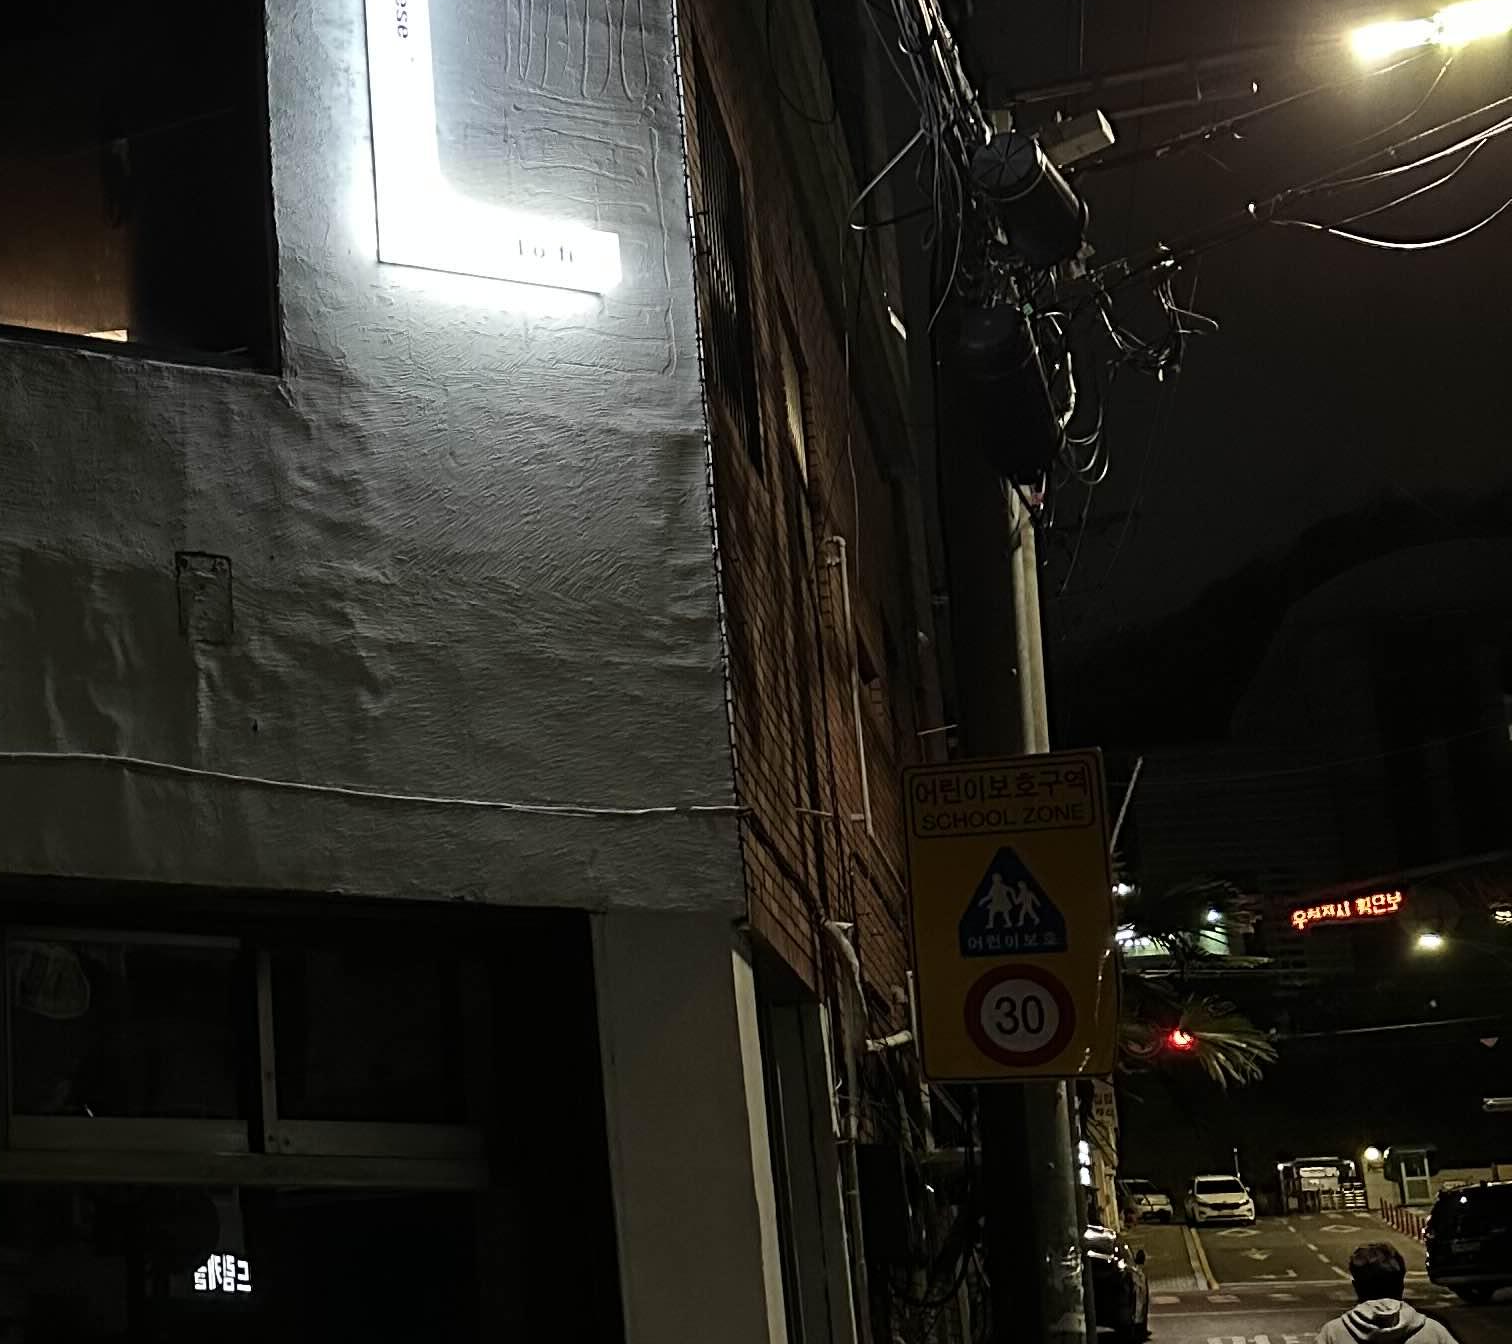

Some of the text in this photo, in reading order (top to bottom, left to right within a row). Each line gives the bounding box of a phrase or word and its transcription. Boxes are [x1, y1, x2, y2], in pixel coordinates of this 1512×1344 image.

[916, 766, 1087, 805] 어린이보호구역
[921, 802, 1084, 831] SCHOOL ZONE
[995, 996, 1044, 1035] 30
